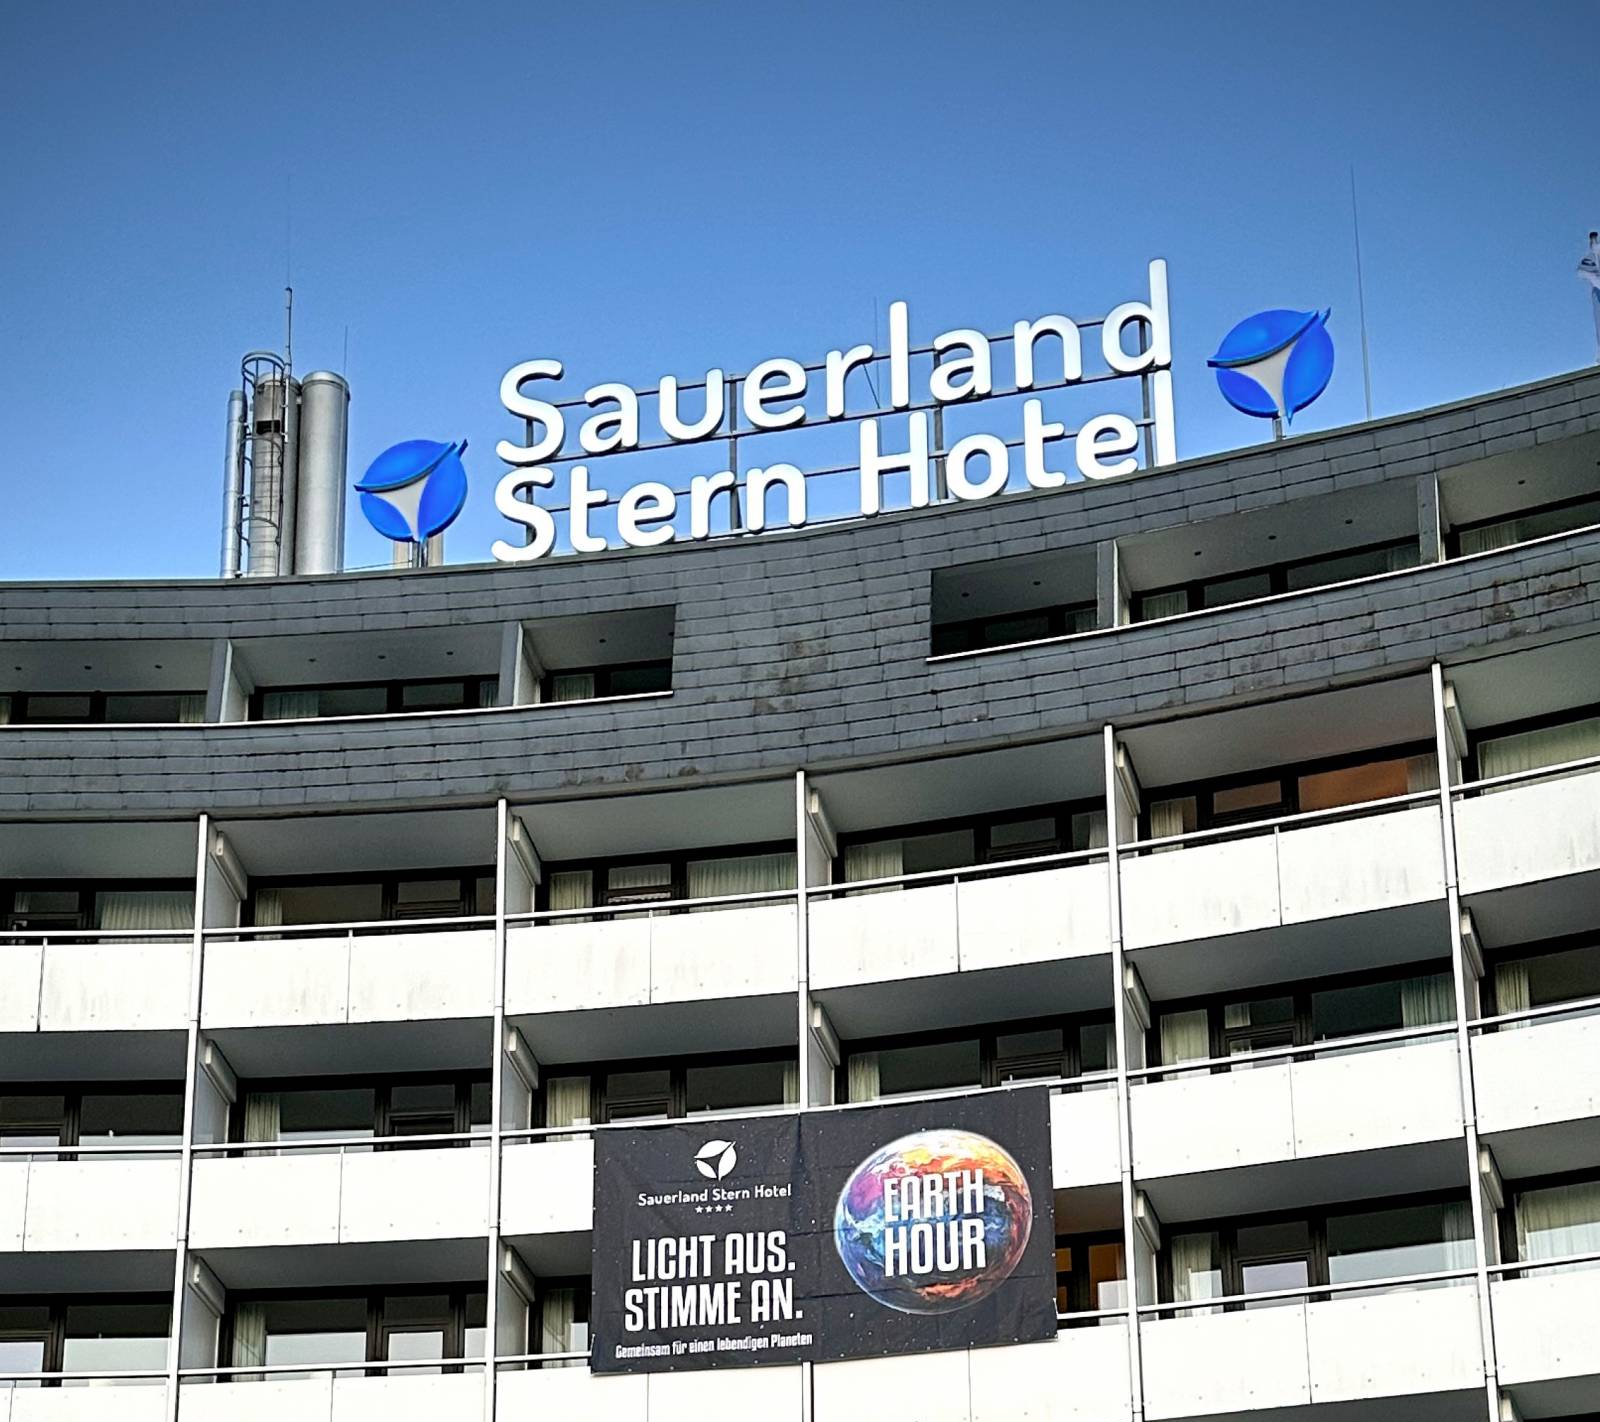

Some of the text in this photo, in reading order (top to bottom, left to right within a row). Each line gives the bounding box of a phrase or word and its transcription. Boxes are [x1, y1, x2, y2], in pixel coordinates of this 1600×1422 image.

[496, 258, 1172, 465] Sauerland
[490, 369, 1178, 563] Stern Hotel
[638, 1183, 792, 1206] Sauerland Stern Hotel
[884, 1168, 984, 1222] EARTH
[631, 1230, 796, 1282] LICHT AUS.
[884, 1218, 986, 1277] HOUR
[624, 1277, 803, 1332] STIMME AN.
[615, 1332, 813, 1359] Gemeinsam für einen lebendigen Planeten
